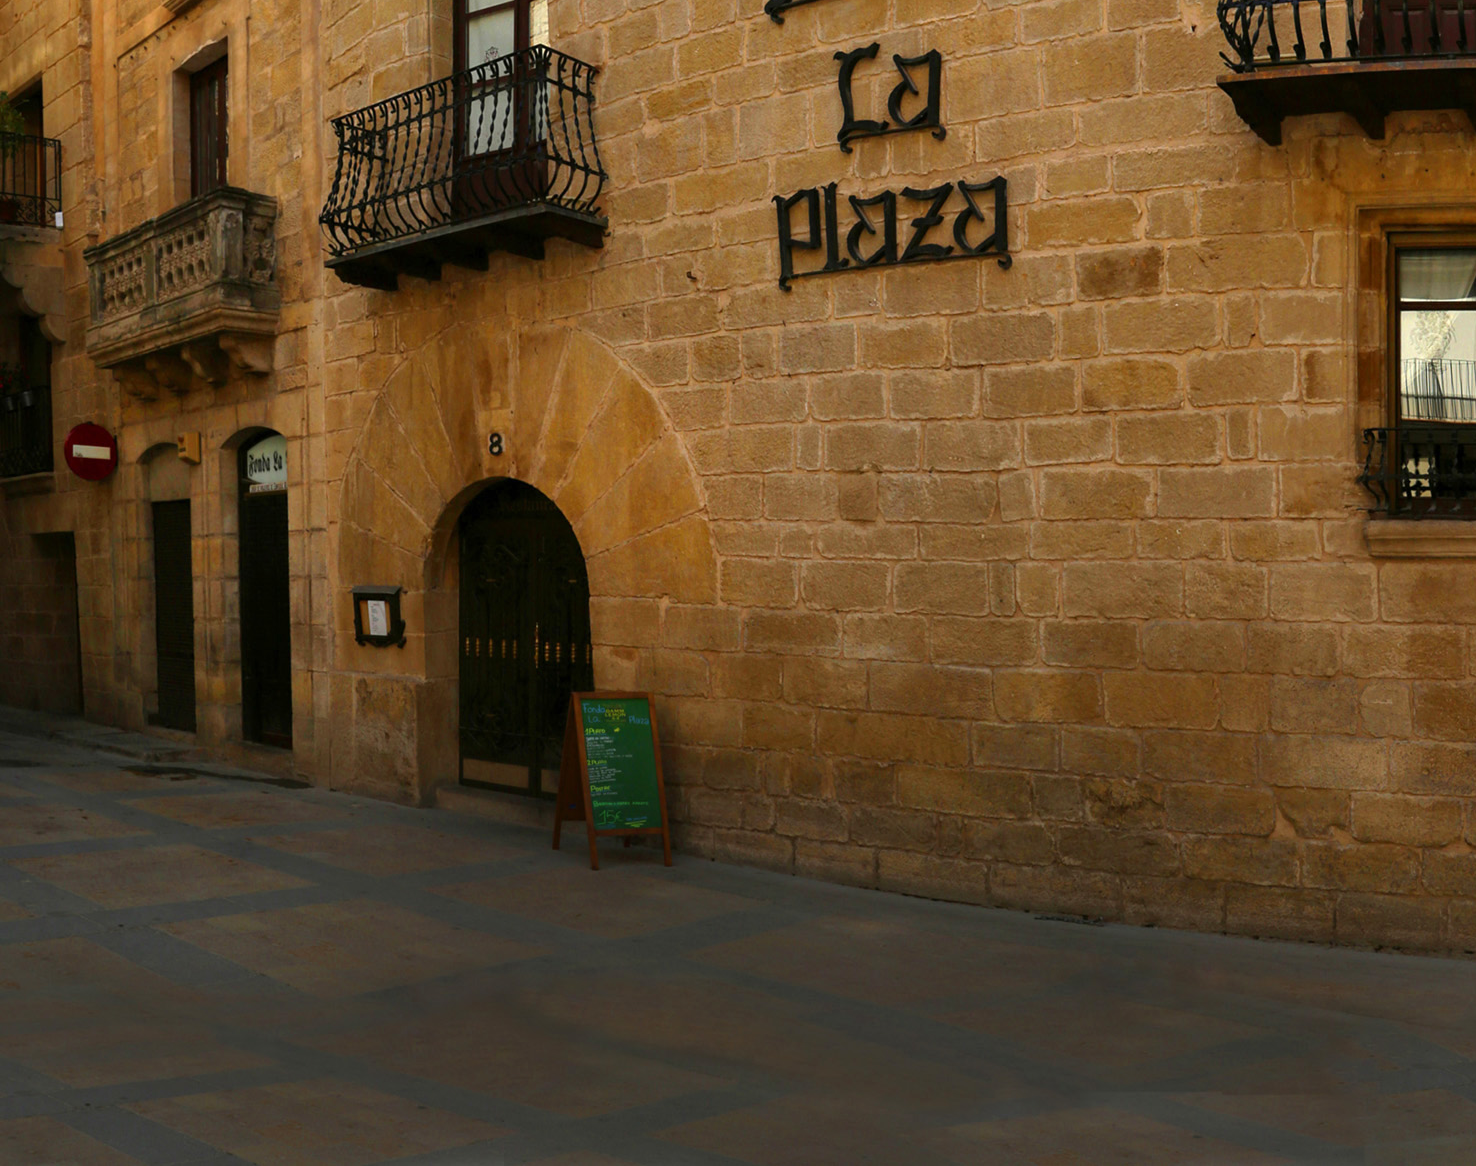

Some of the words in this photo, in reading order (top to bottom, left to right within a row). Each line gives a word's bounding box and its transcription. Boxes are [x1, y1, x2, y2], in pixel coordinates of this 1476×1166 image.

[833, 42, 943, 144] La
[772, 175, 1008, 284] Plaza
[488, 432, 503, 456] 8
[248, 452, 271, 478] Fonda
[273, 450, 283, 472] La
[582, 702, 606, 714] Fonda
[628, 714, 650, 725] Plaza
[597, 809, 623, 826] 15€
